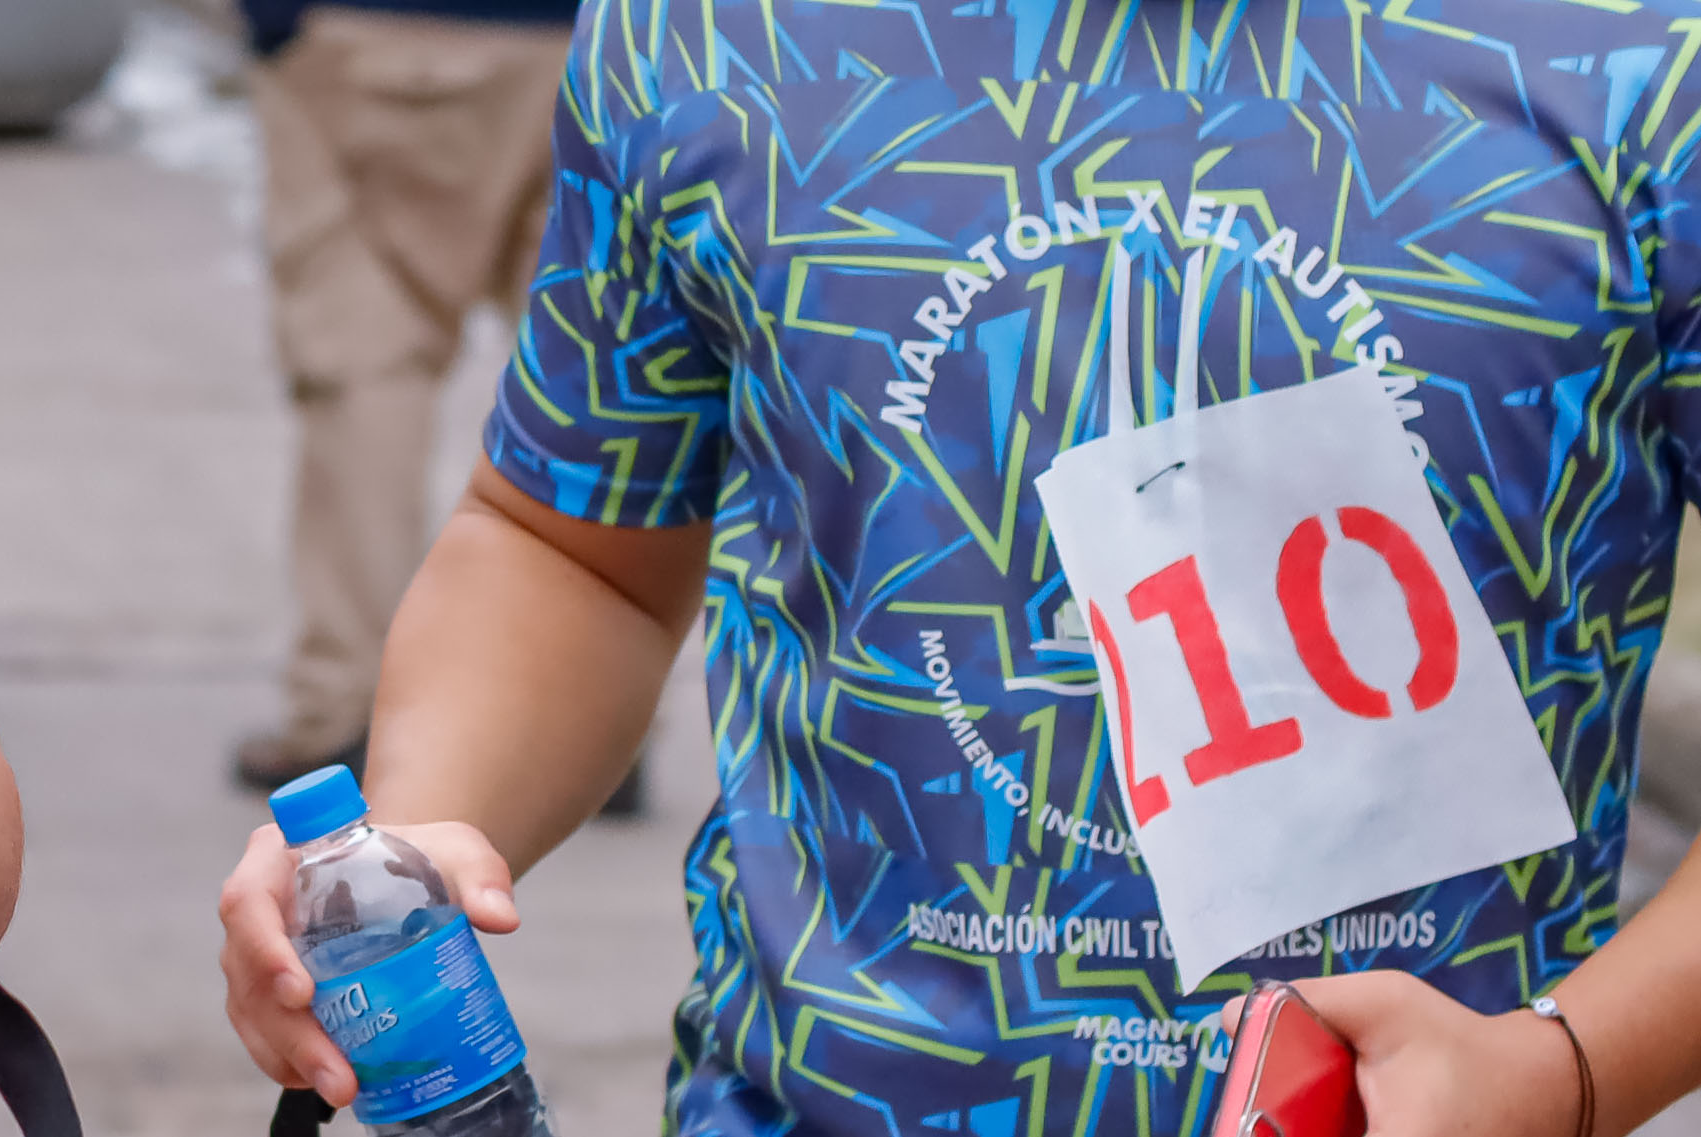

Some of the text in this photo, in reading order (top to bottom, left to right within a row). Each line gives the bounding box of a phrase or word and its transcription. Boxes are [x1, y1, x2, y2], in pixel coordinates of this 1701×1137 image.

[881, 194, 1102, 434] MARATÓN
[1125, 190, 1164, 235] X
[1182, 194, 1240, 251] EL
[918, 629, 1142, 858] MOVIMIENTO, INCLUS
[908, 902, 1057, 955] ASOCIACIÓN
[1064, 916, 1139, 958] CIVIL
[1329, 910, 1436, 953] UNIDOS
[1074, 1015, 1190, 1044] MAGNY
[1093, 1041, 1189, 1069] COURS
